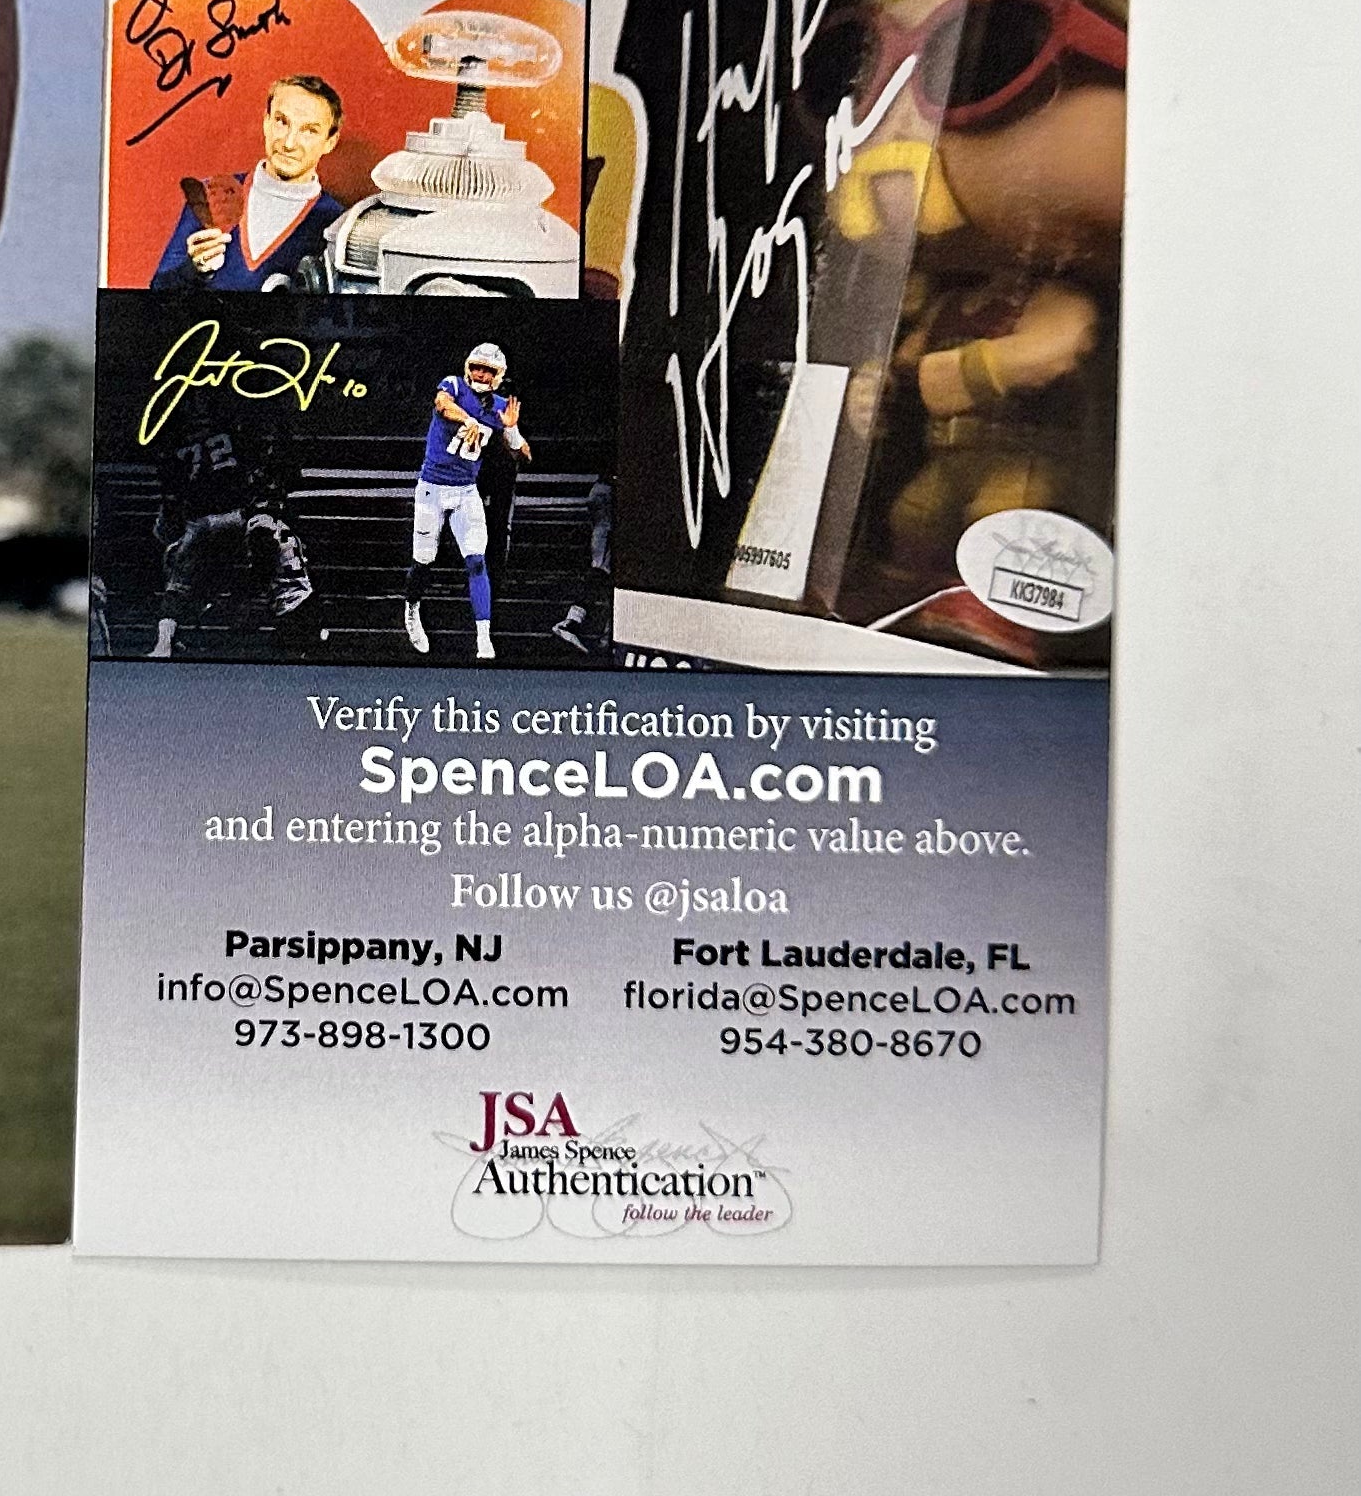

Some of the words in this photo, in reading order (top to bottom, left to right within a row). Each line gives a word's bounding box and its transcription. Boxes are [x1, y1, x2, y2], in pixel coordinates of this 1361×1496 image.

[306, 695, 423, 743] Verify
[432, 696, 502, 735] this
[511, 698, 736, 740] certification
[745, 701, 792, 752] by
[800, 706, 940, 756] visiting
[359, 744, 884, 804] SpenceLOA.com
[204, 804, 275, 842] and
[286, 810, 443, 857] entering
[453, 809, 513, 847] the
[522, 809, 798, 858] alpha-numeric
[807, 816, 906, 854] value
[913, 818, 1031, 858] above.
[449, 871, 583, 911] Follow
[590, 883, 635, 911] us
[643, 875, 791, 923] @jsaloa
[224, 929, 444, 966] Parsippany,
[454, 933, 504, 963] NJ
[672, 937, 751, 967] Fort
[760, 939, 976, 976] Lauderdale,
[986, 942, 1032, 971] FL
[156, 971, 570, 1010] info@SpenceLOA.com
[622, 979, 1077, 1018] florida@SpenceLOA.com
[233, 1018, 492, 1052] 973-898-1300
[718, 1026, 983, 1059] 954-380-8670
[469, 1090, 582, 1153] JSA
[499, 1137, 560, 1162] James
[564, 1138, 637, 1165] Spence
[621, 1203, 679, 1224] follow
[684, 1203, 712, 1223] the
[716, 1204, 775, 1223] leader
